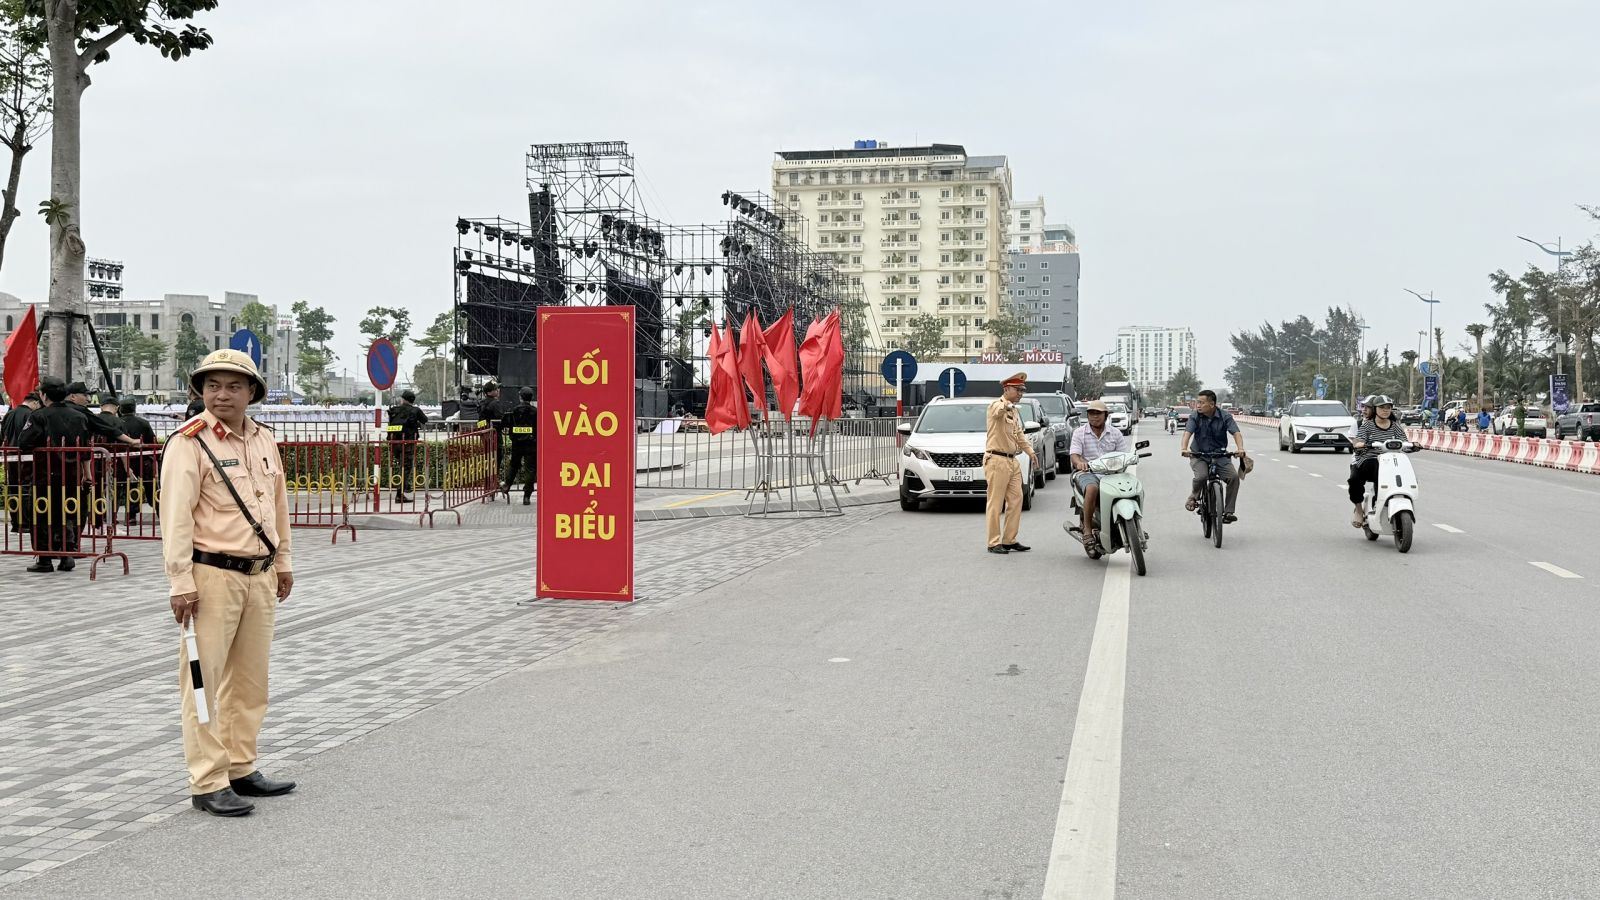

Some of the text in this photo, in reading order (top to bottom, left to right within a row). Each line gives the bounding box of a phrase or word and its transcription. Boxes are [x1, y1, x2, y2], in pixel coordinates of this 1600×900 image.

[563, 347, 609, 385] LỐI
[1026, 353, 1063, 363] MIXUE
[552, 403, 619, 437] VÀO
[559, 462, 611, 496] ĐẠI
[555, 500, 616, 540] BIỂU
